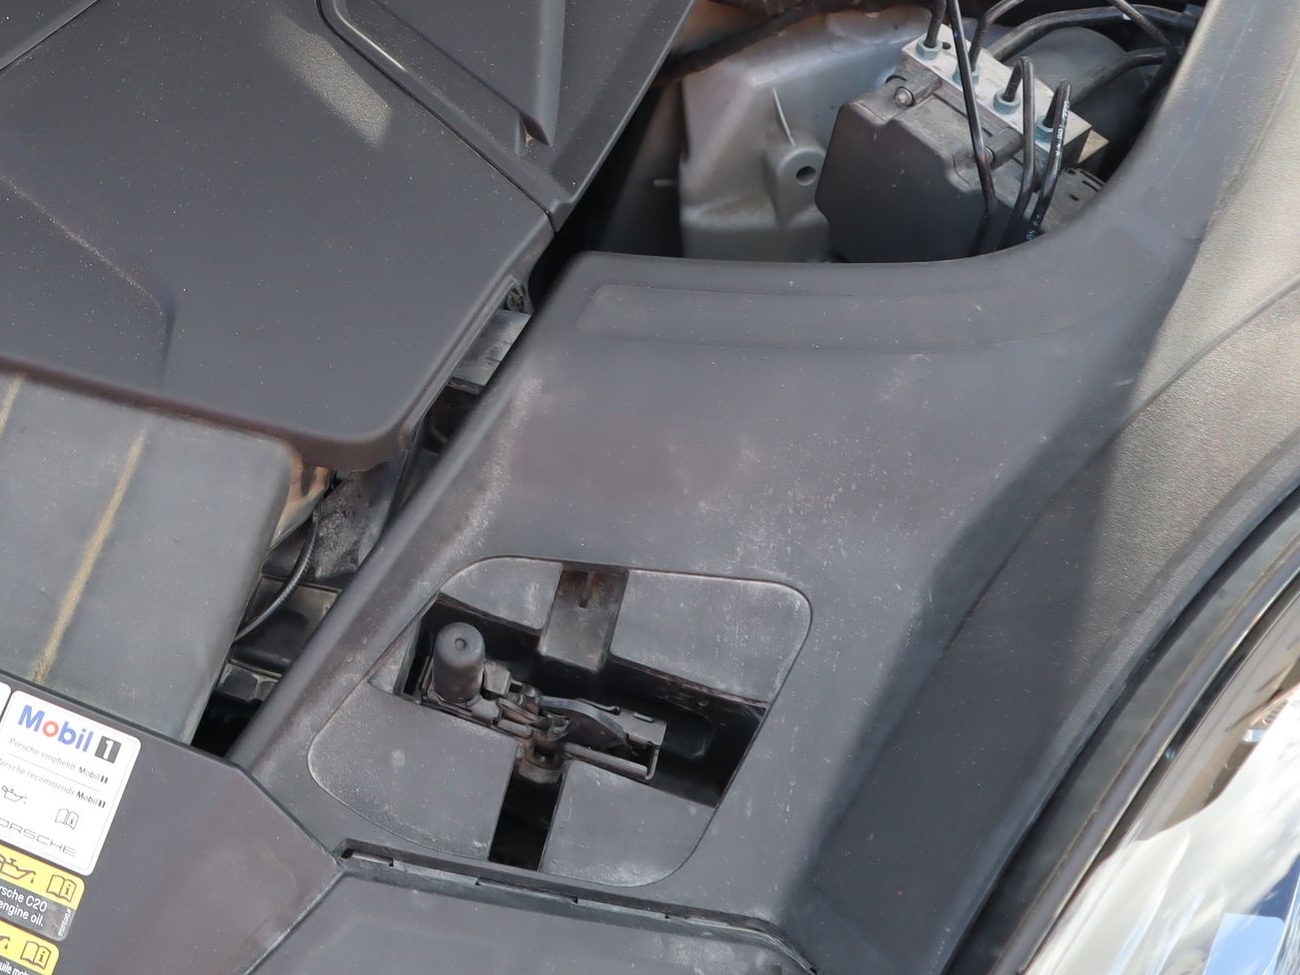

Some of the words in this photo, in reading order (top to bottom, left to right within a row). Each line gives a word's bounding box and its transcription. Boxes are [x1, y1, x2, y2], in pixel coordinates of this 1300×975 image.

[17, 704, 94, 753] Mobil
[8, 737, 40, 756] Porsche
[77, 765, 101, 782] Mobil
[26, 771, 76, 796] recommends
[75, 789, 99, 806] Mobil
[25, 895, 48, 913] C20
[30, 911, 45, 927] oil.
